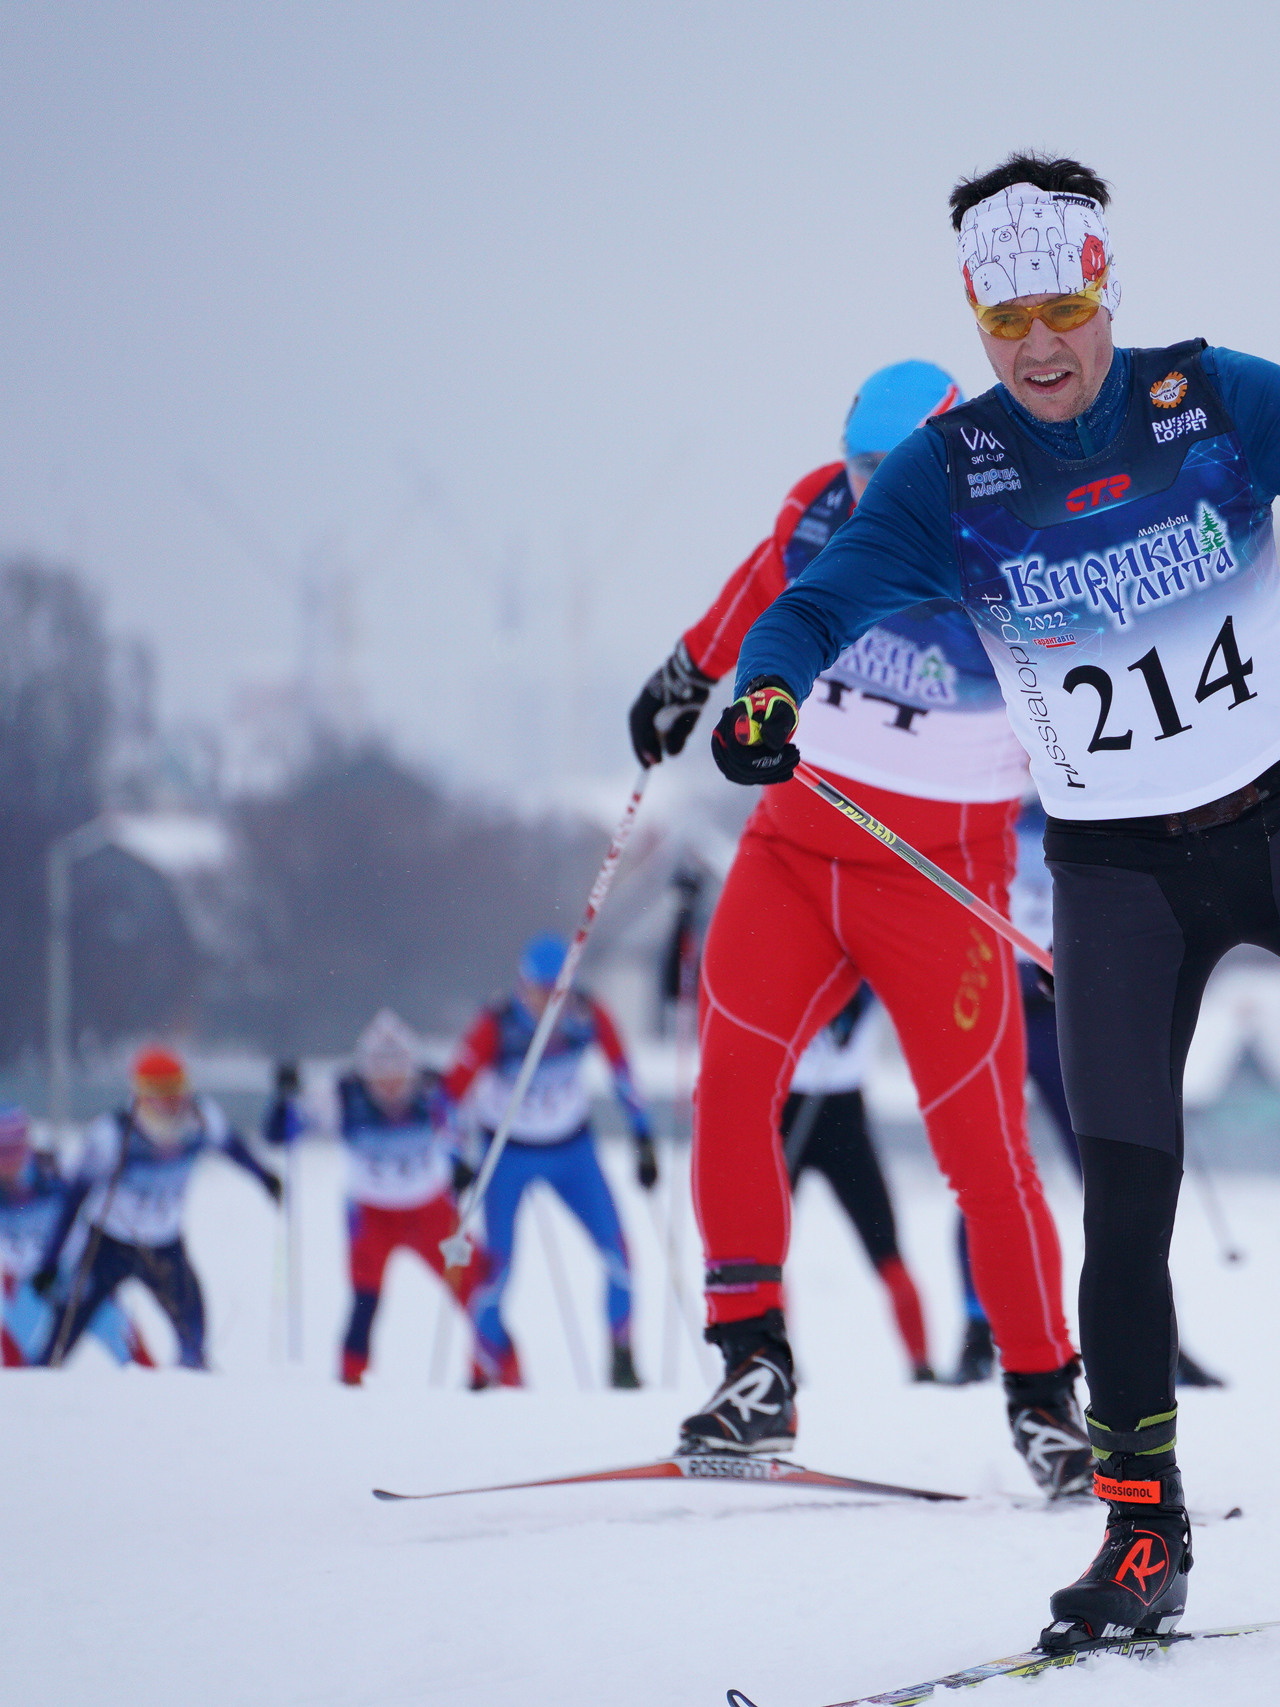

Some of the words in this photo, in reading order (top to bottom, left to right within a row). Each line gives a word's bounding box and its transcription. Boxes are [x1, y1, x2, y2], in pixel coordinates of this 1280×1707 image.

[1152, 407, 1206, 433] RUSSIA
[1155, 418, 1207, 444] LOPPET
[971, 454, 985, 465] SKI
[986, 453, 1005, 462] CUP
[1138, 514, 1189, 538] марафон
[1024, 611, 1067, 631] 2022
[982, 593, 1086, 789] russialoppet
[1062, 615, 1258, 754] 214
[1101, 1483, 1153, 1498] ROSSIGNOL
[1115, 1538, 1166, 1592] R
